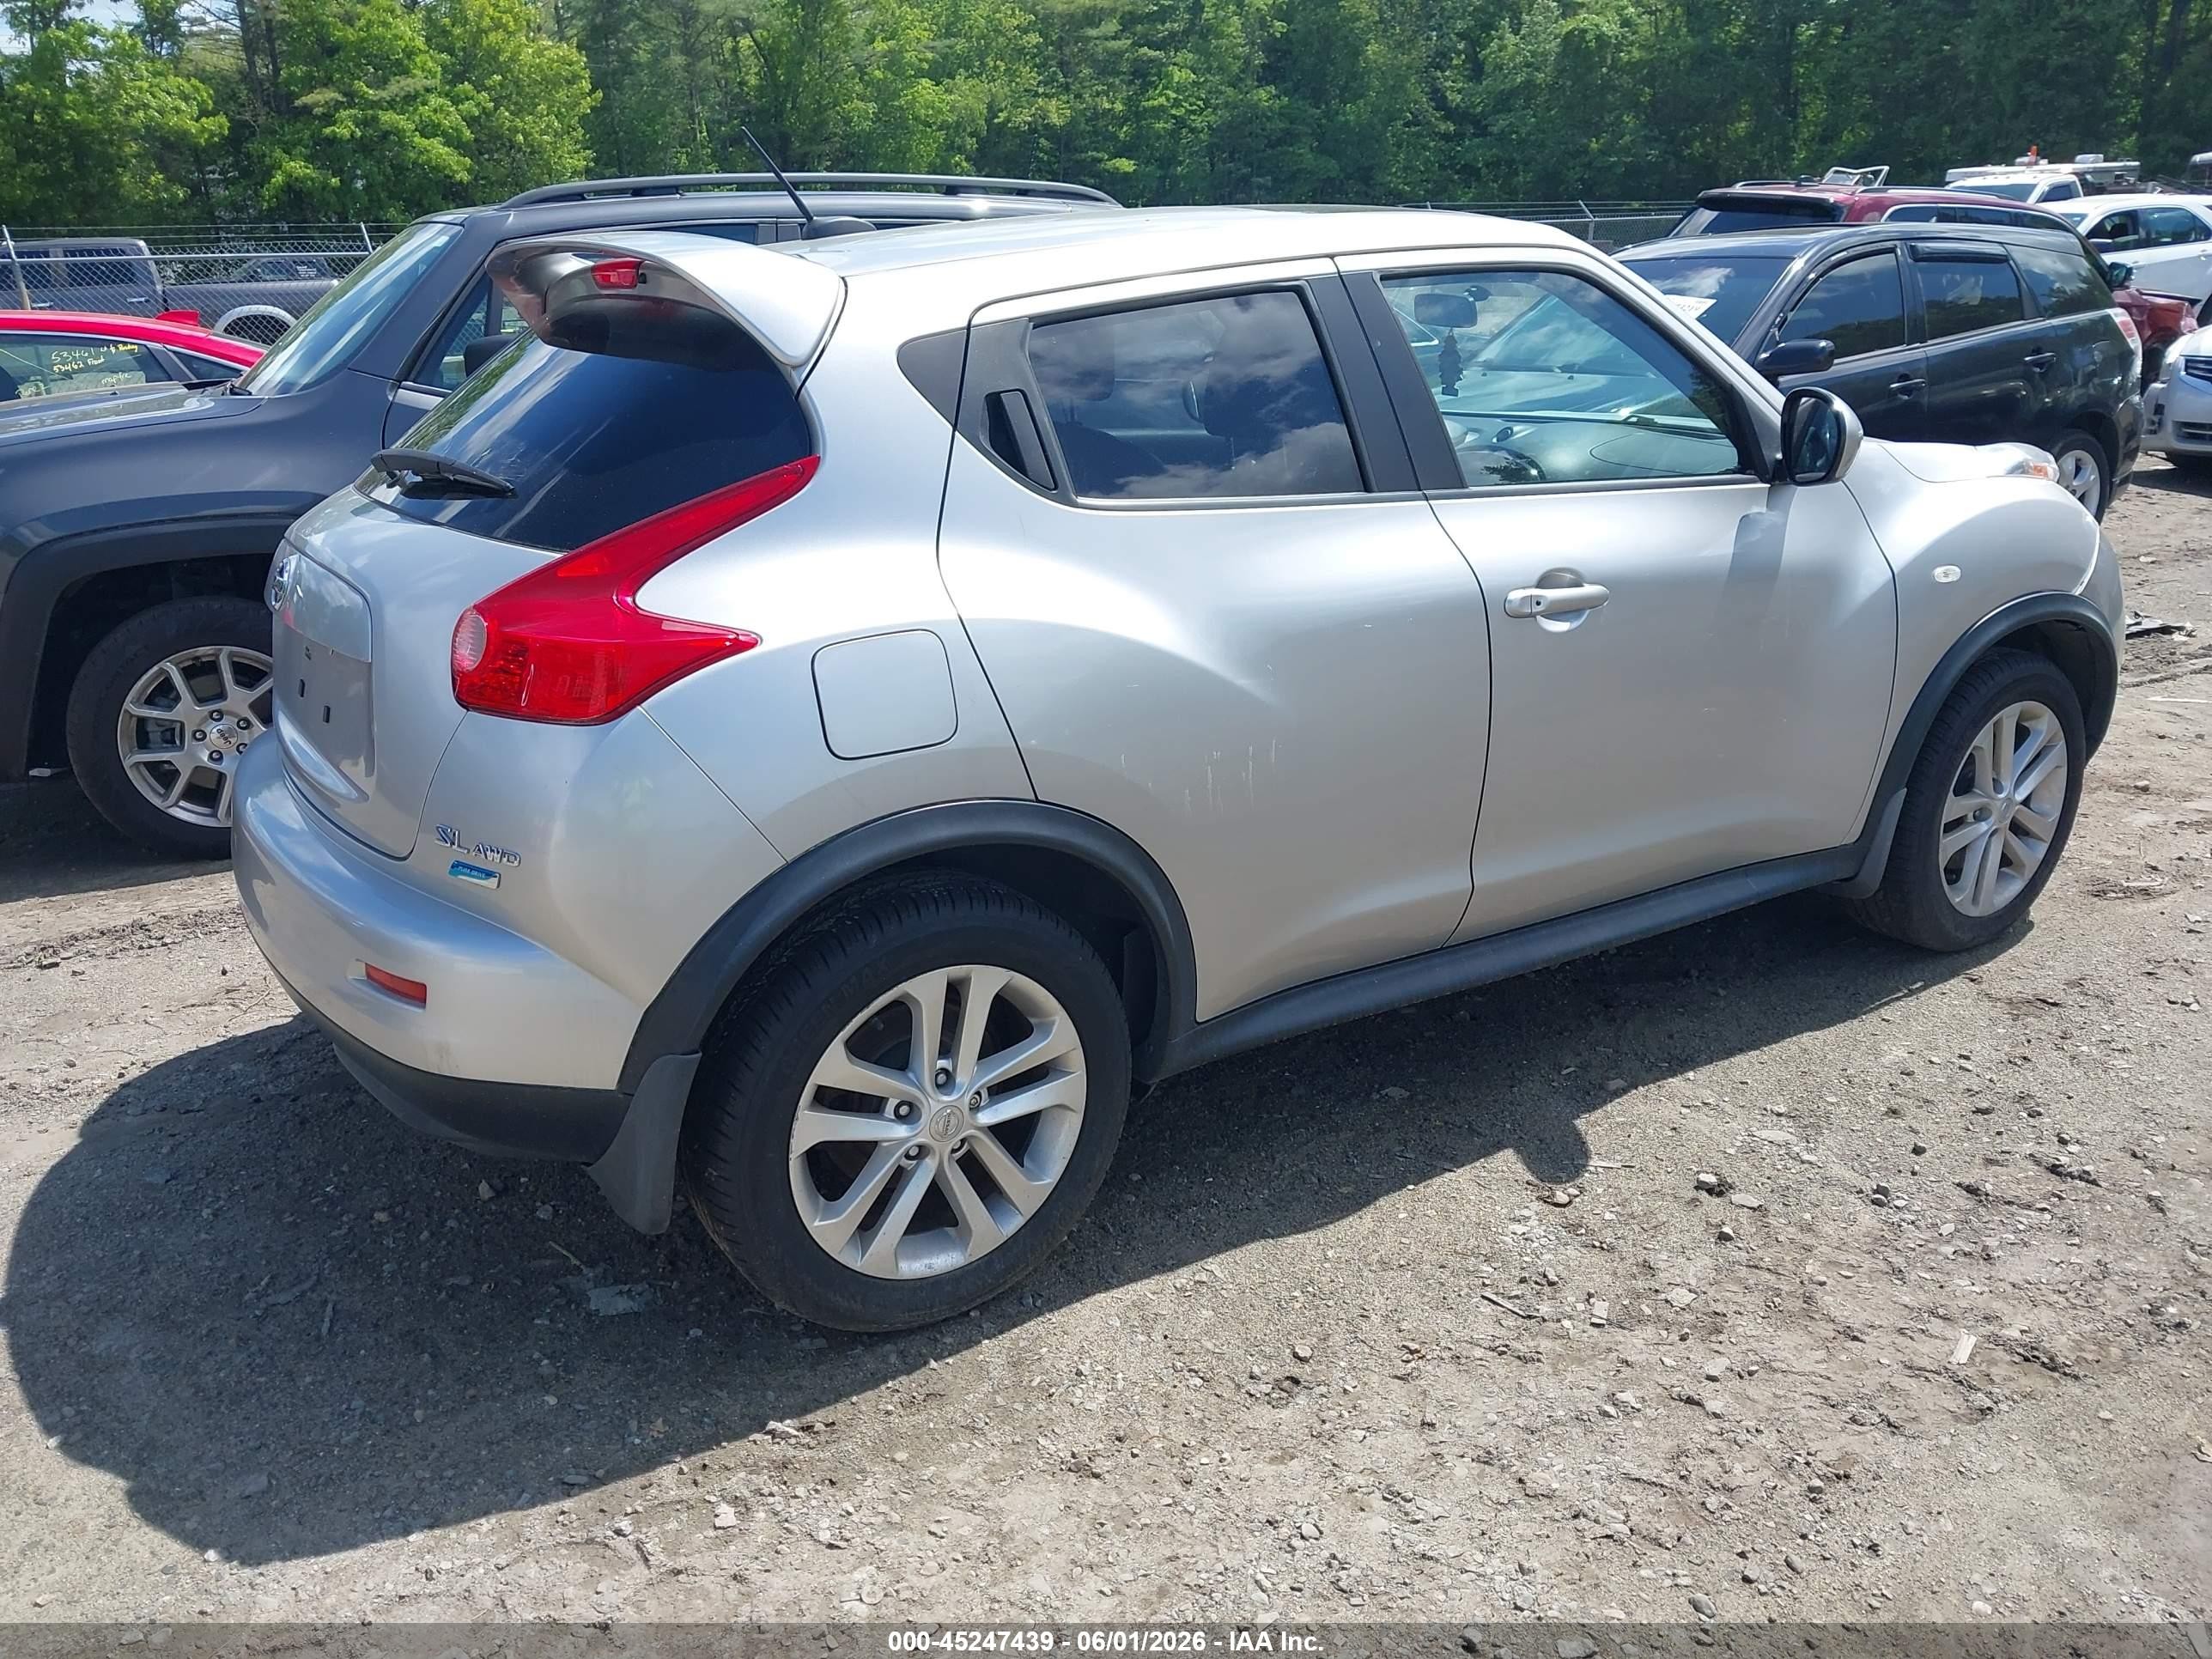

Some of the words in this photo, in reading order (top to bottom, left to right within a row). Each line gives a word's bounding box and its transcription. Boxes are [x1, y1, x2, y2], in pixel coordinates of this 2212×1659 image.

[53, 361, 84, 373] 53462
[216, 728, 232, 745] Jeep
[434, 824, 470, 854] SL
[472, 842, 521, 867] AWD
